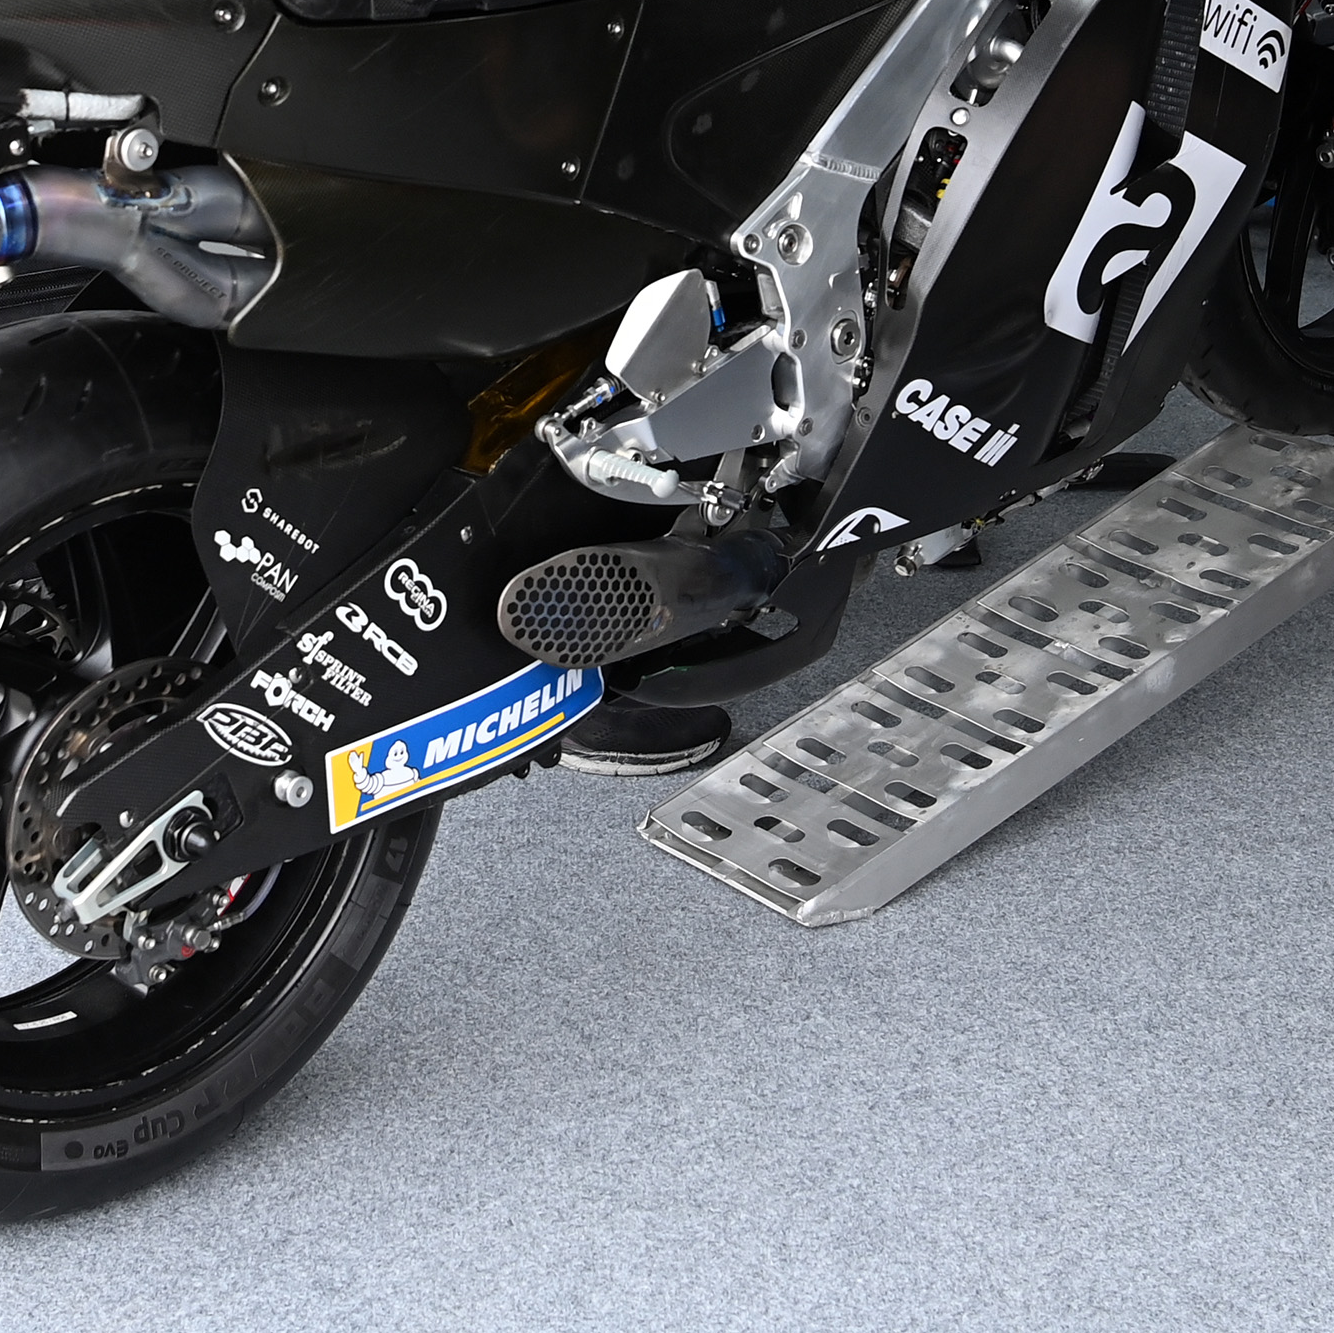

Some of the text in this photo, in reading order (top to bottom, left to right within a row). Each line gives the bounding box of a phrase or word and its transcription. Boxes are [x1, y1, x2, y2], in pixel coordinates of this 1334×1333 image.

[894, 378, 992, 453] CASE
[262, 507, 320, 554] SHAREBOT
[255, 552, 299, 594] PAN
[397, 571, 435, 614] REGINA
[314, 649, 366, 688] SPRINT
[362, 622, 419, 676] RCB
[321, 667, 373, 707] FILTER
[423, 668, 584, 769] MICHELIN
